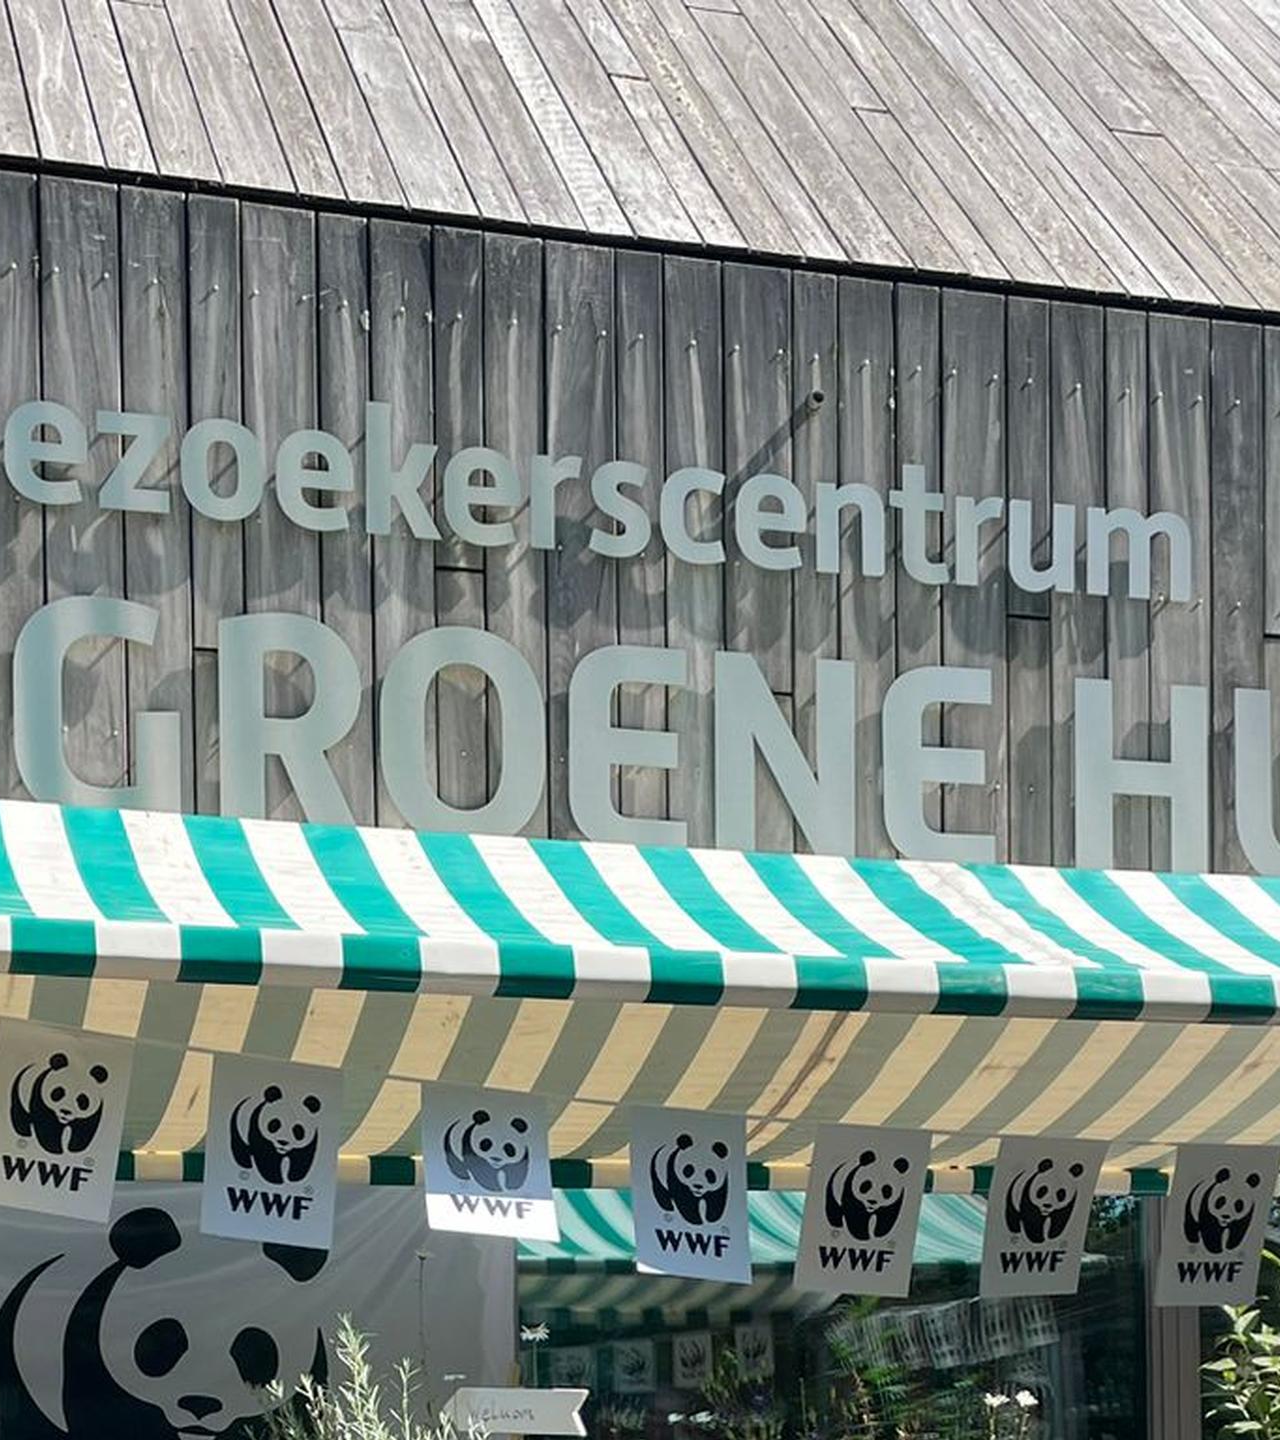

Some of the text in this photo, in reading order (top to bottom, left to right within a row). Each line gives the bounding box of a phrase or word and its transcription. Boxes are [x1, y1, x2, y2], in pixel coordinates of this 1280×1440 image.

[12, 595, 996, 860] GROENE
[2, 1154, 94, 1193] WWF
[227, 1186, 314, 1221] WWF
[449, 1193, 532, 1220] WWF
[655, 1227, 729, 1259] WWF
[820, 1244, 896, 1273] WWF
[1000, 1250, 1064, 1274] WWF
[1177, 1260, 1243, 1285] WWF
